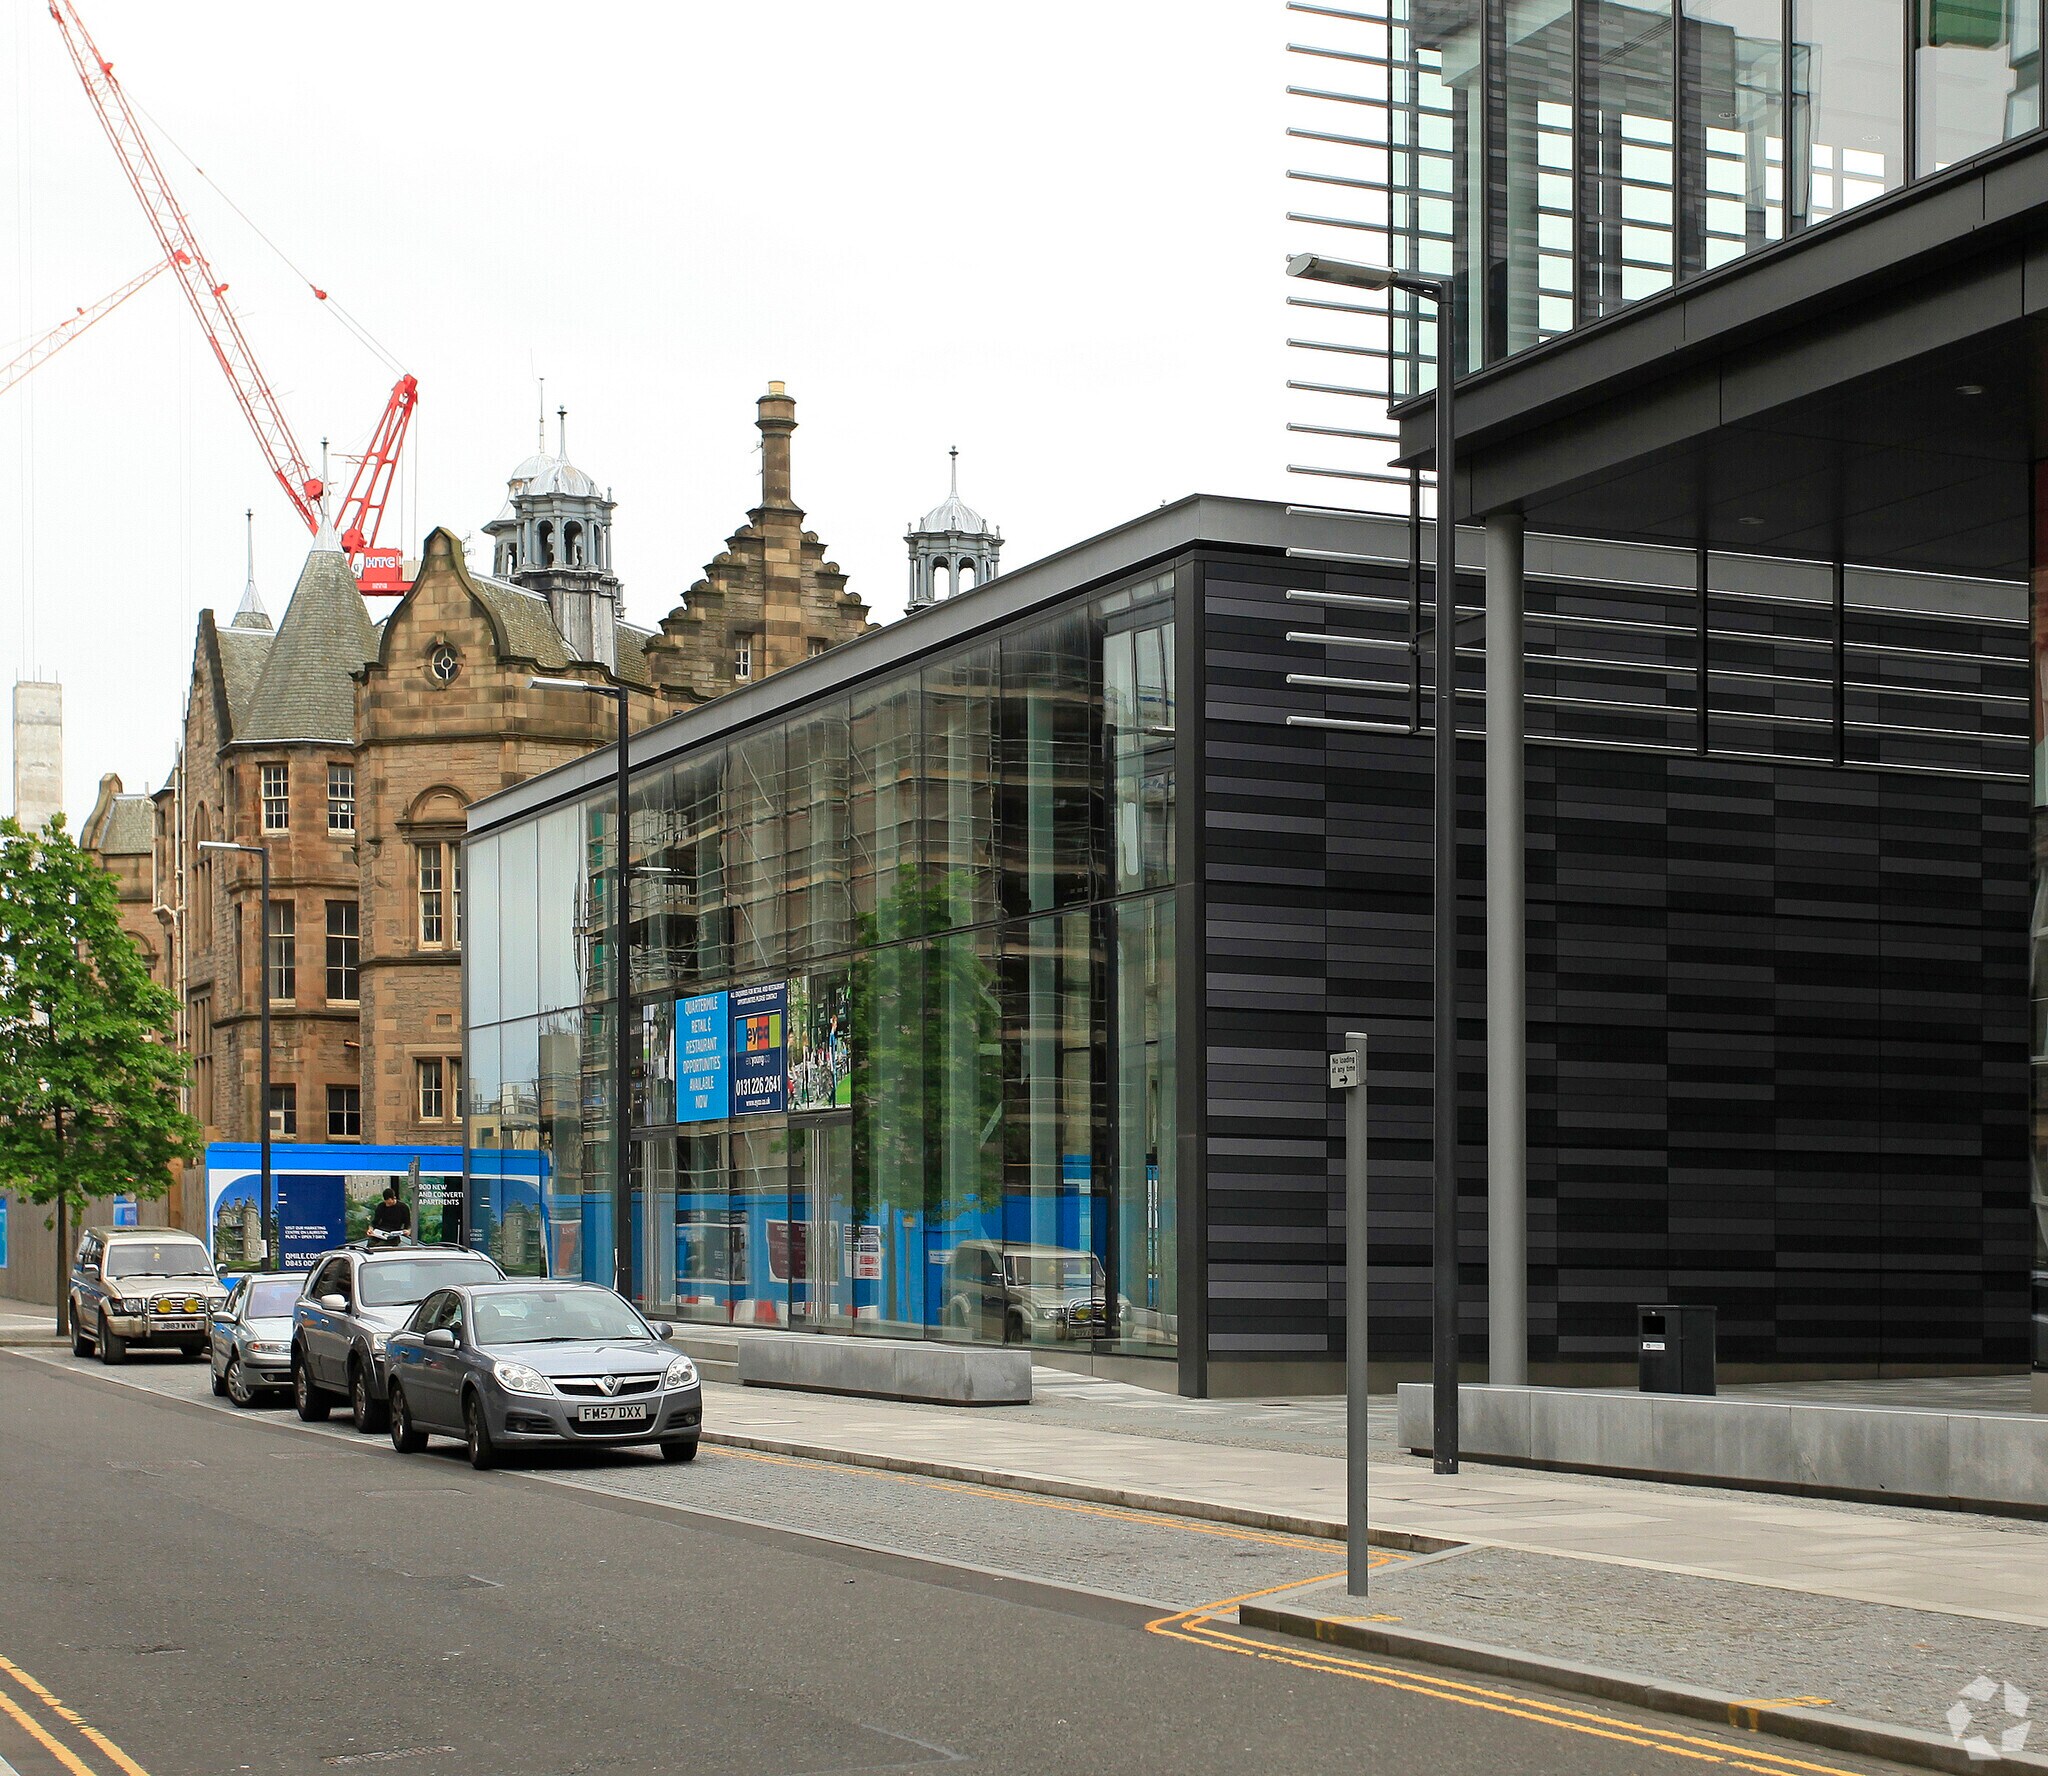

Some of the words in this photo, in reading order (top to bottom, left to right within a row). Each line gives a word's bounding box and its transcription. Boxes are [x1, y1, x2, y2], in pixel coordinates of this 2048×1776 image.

[365, 556, 396, 568] HTC
[685, 996, 717, 1016] QUARTERMILE
[691, 1018, 708, 1034] RETAIL
[686, 1037, 717, 1054] RESTAURANT
[683, 1056, 720, 1074] OPPORTUNITIES
[690, 1076, 714, 1091] AVAILABLE
[736, 1078, 751, 1096] 0131
[751, 1076, 764, 1095] 226
[765, 1075, 781, 1093] 2641
[695, 1095, 709, 1108] NOW
[285, 1252, 320, 1260] QMILE.COM
[584, 1408, 615, 1419] FM57
[619, 1406, 641, 1418] DXX
